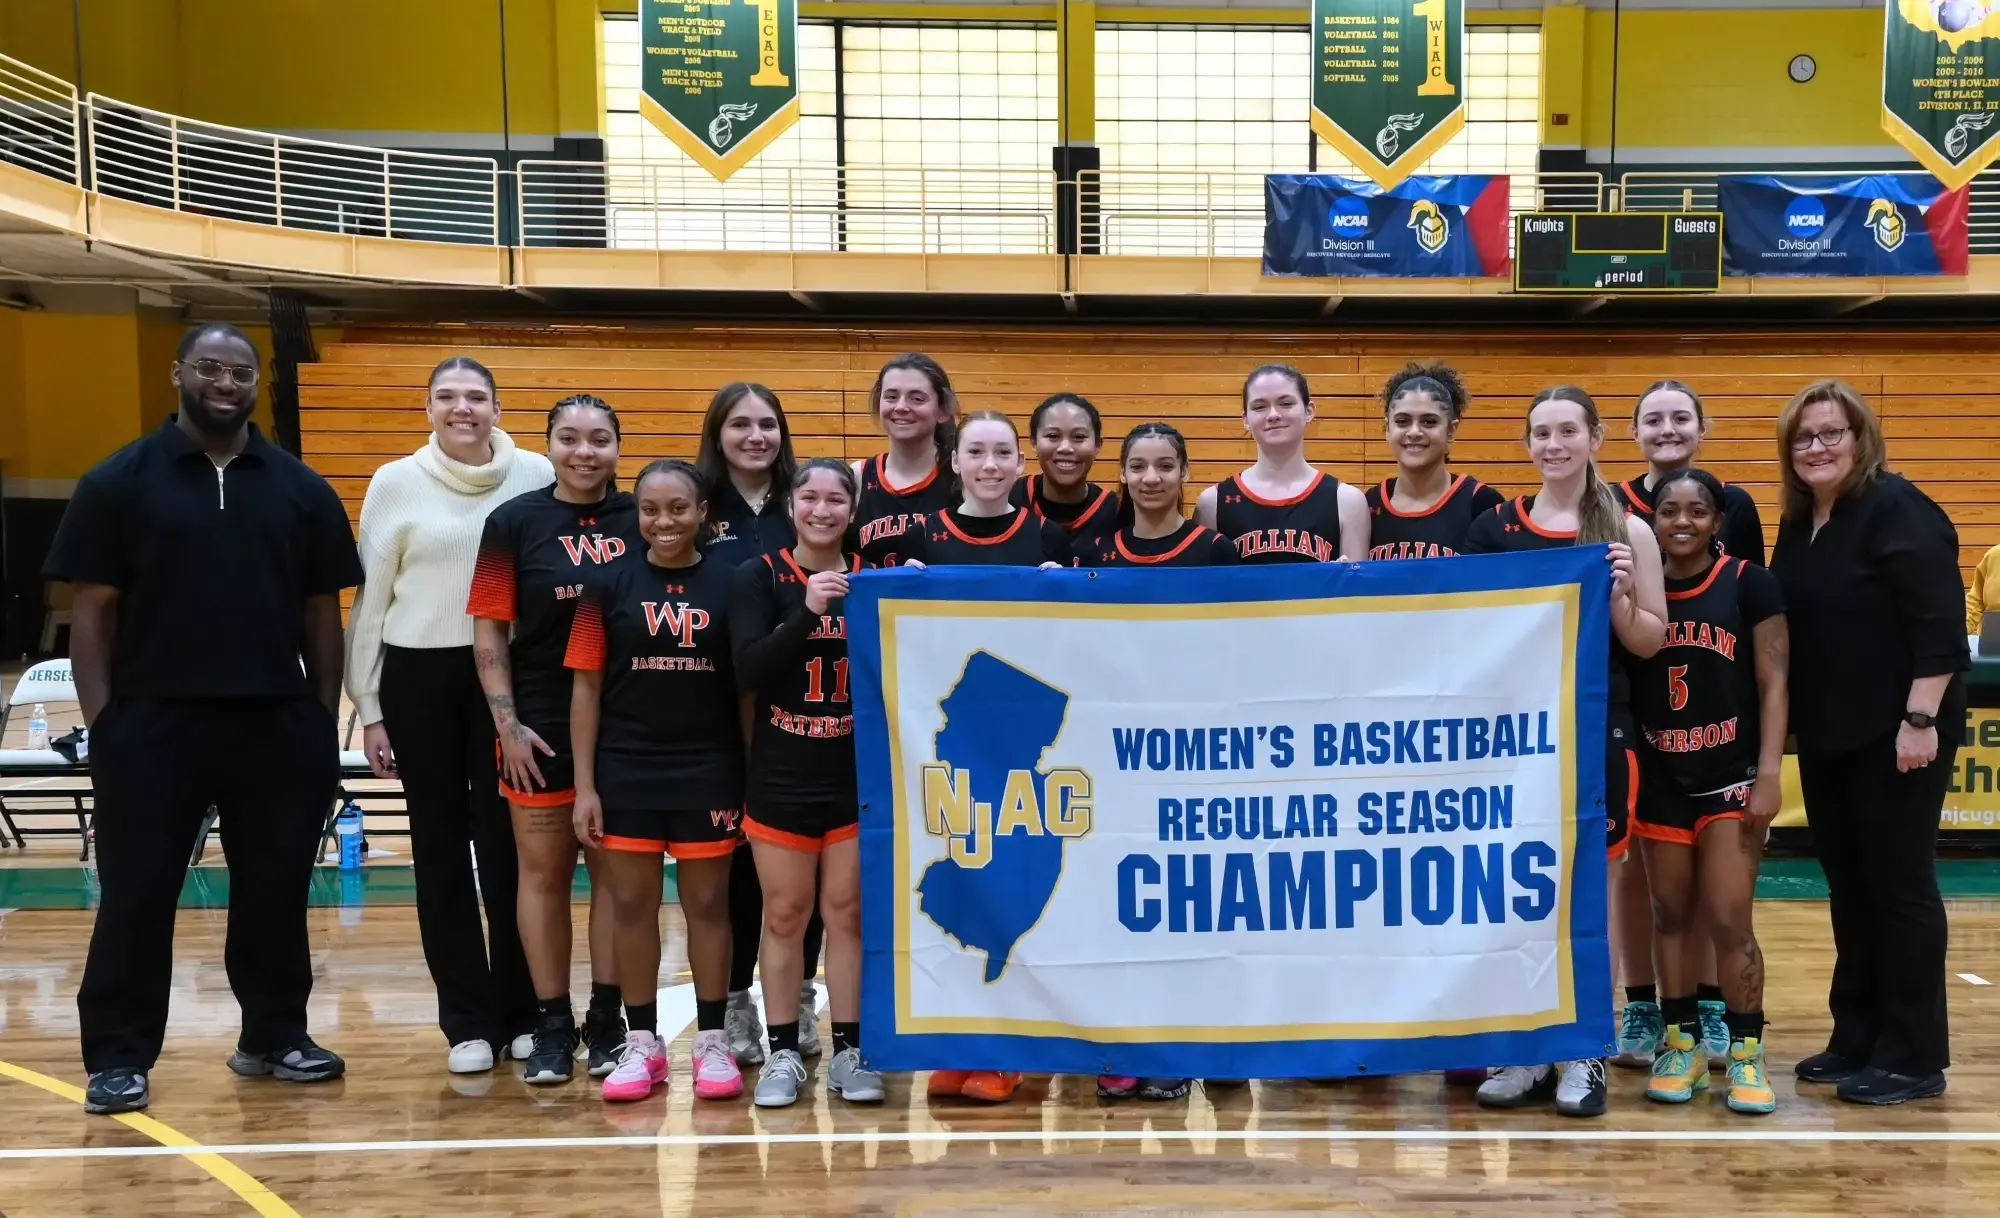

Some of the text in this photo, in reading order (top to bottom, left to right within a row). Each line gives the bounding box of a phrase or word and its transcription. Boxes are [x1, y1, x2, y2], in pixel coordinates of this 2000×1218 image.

[658, 17, 725, 27] MEN'S OUTDOOR
[1324, 16, 1377, 24] BASKETBALL
[662, 26, 690, 34] TRACK
[699, 27, 722, 35] FIELD
[1324, 31, 1399, 39] VOLLEYBALL 2001
[646, 47, 738, 58] WOMEN'S VOLLEYBALL
[1324, 45, 1366, 53] SOFTBALL
[1324, 60, 1399, 68] VOLLEYBALL 2004
[1936, 56, 1956, 64] 2005
[1964, 56, 1984, 64] 2006
[662, 69, 723, 79] MEN'S INDOOR
[1936, 68, 1955, 76] 2009
[1963, 68, 1983, 76] 2010
[662, 77, 690, 86] TRACK
[699, 79, 723, 87] FIELD
[1324, 74, 1366, 82] SOFTBALL
[1912, 78, 2000, 87] WOMEN'S BOWLIN
[1953, 90, 1984, 98] PLACE
[1919, 101, 1962, 110] DIVISION
[1986, 101, 1999, 110] III
[1333, 215, 1368, 227] NCAA
[1524, 218, 1564, 233] Knights
[1674, 218, 1716, 233] Guests
[1789, 215, 1824, 227] NCAA
[1323, 238, 1375, 251] Division III
[1778, 239, 1831, 250] Division III
[1605, 269, 1643, 285] period
[558, 534, 626, 567] WP
[641, 601, 709, 648] WP
[804, 656, 849, 703] 11
[1668, 664, 1689, 711] 5
[1113, 711, 1556, 770] WOMEN'S BASKETBALL
[922, 766, 1092, 869] NJAC
[1158, 785, 1514, 842] REGULAR SEASON
[1117, 841, 1557, 933] CHAMPIONS
